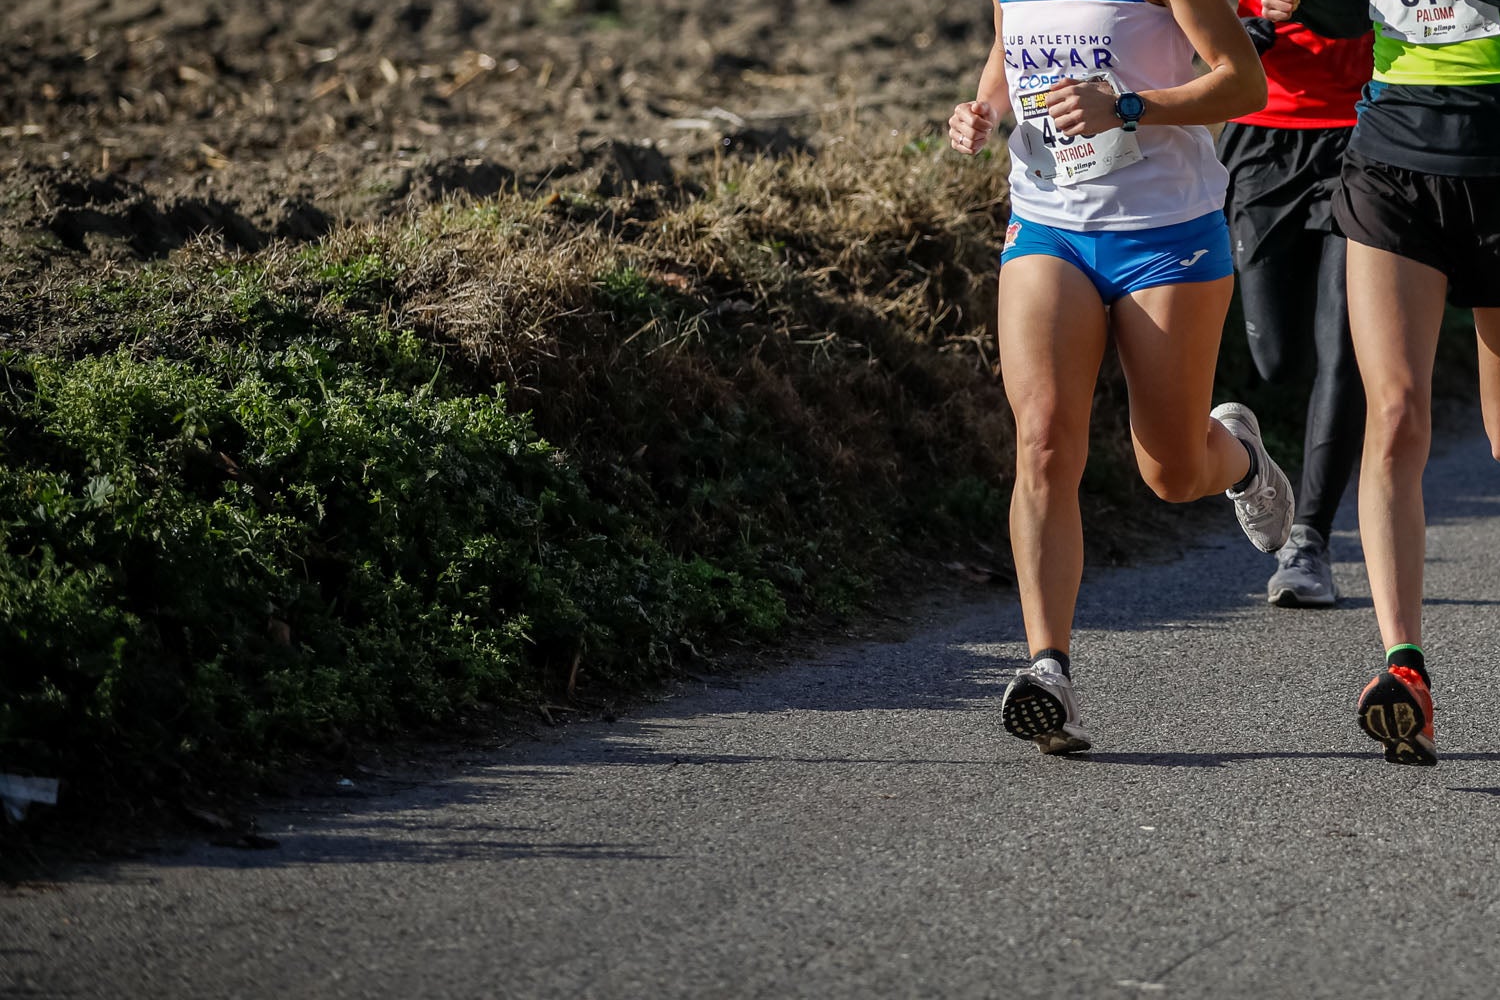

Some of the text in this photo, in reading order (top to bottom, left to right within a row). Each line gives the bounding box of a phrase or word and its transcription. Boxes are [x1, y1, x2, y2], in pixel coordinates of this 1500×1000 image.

[1416, 6, 1455, 22] PALOMA
[1030, 35, 1112, 46] ATLETISMO
[1005, 48, 1113, 70] CAXAR
[1055, 142, 1096, 164] PATRICIA
